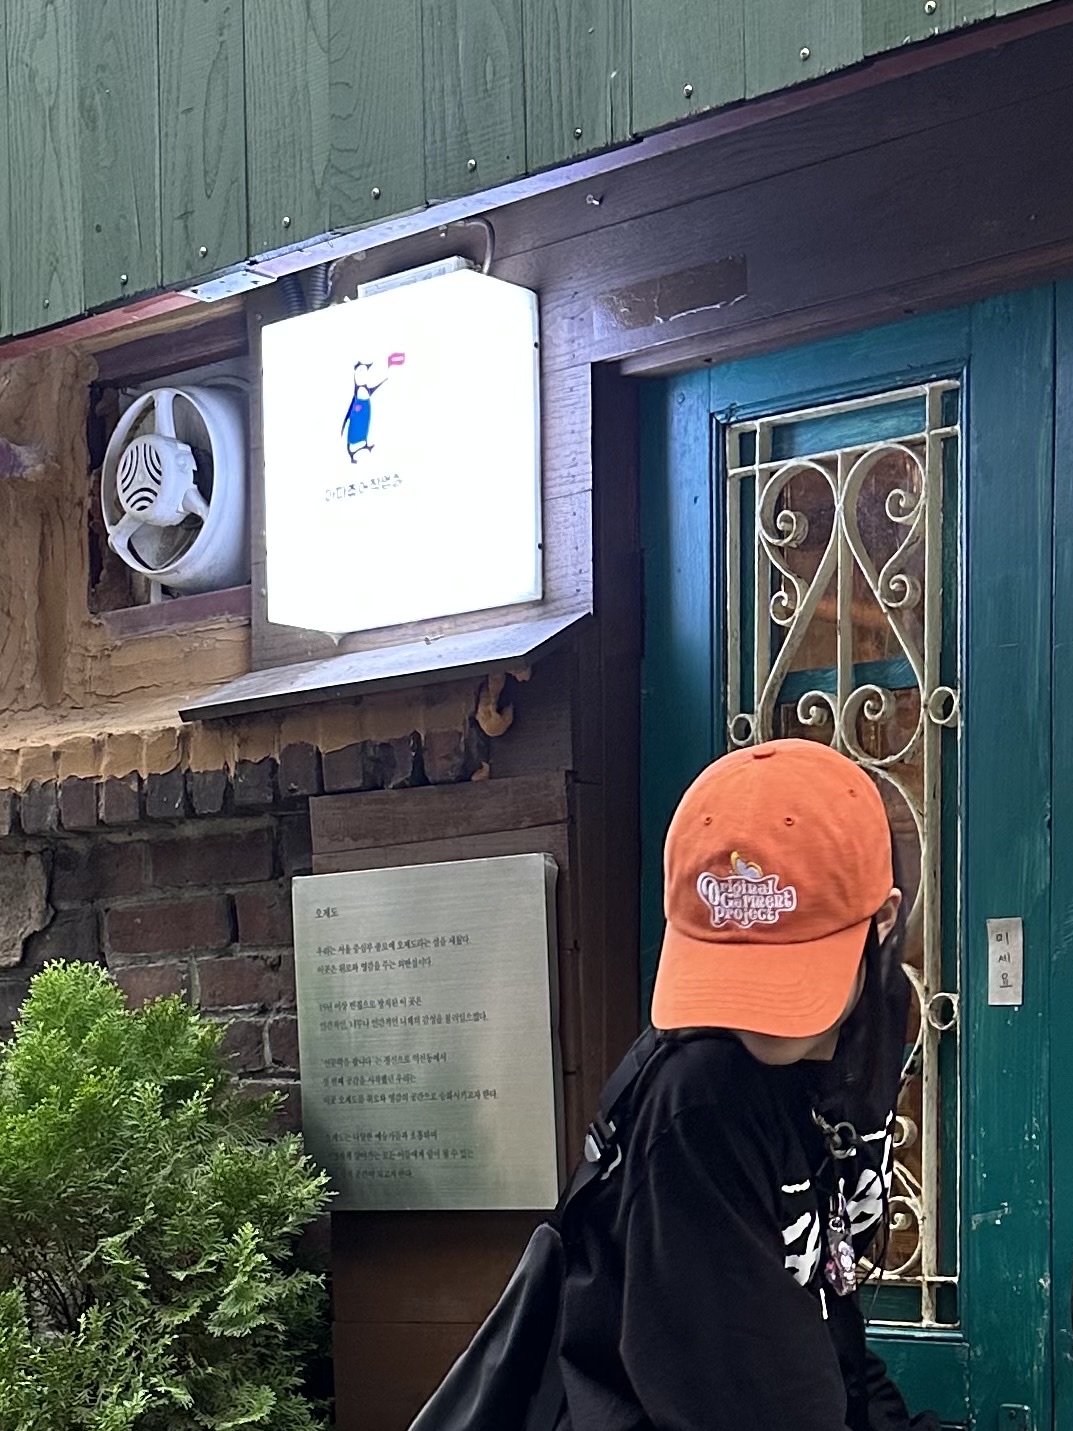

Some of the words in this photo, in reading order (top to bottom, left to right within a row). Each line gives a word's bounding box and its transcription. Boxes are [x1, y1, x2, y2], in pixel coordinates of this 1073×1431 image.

[702, 877, 774, 905] Original
[720, 891, 793, 908] Garment
[315, 907, 339, 919] 오제도
